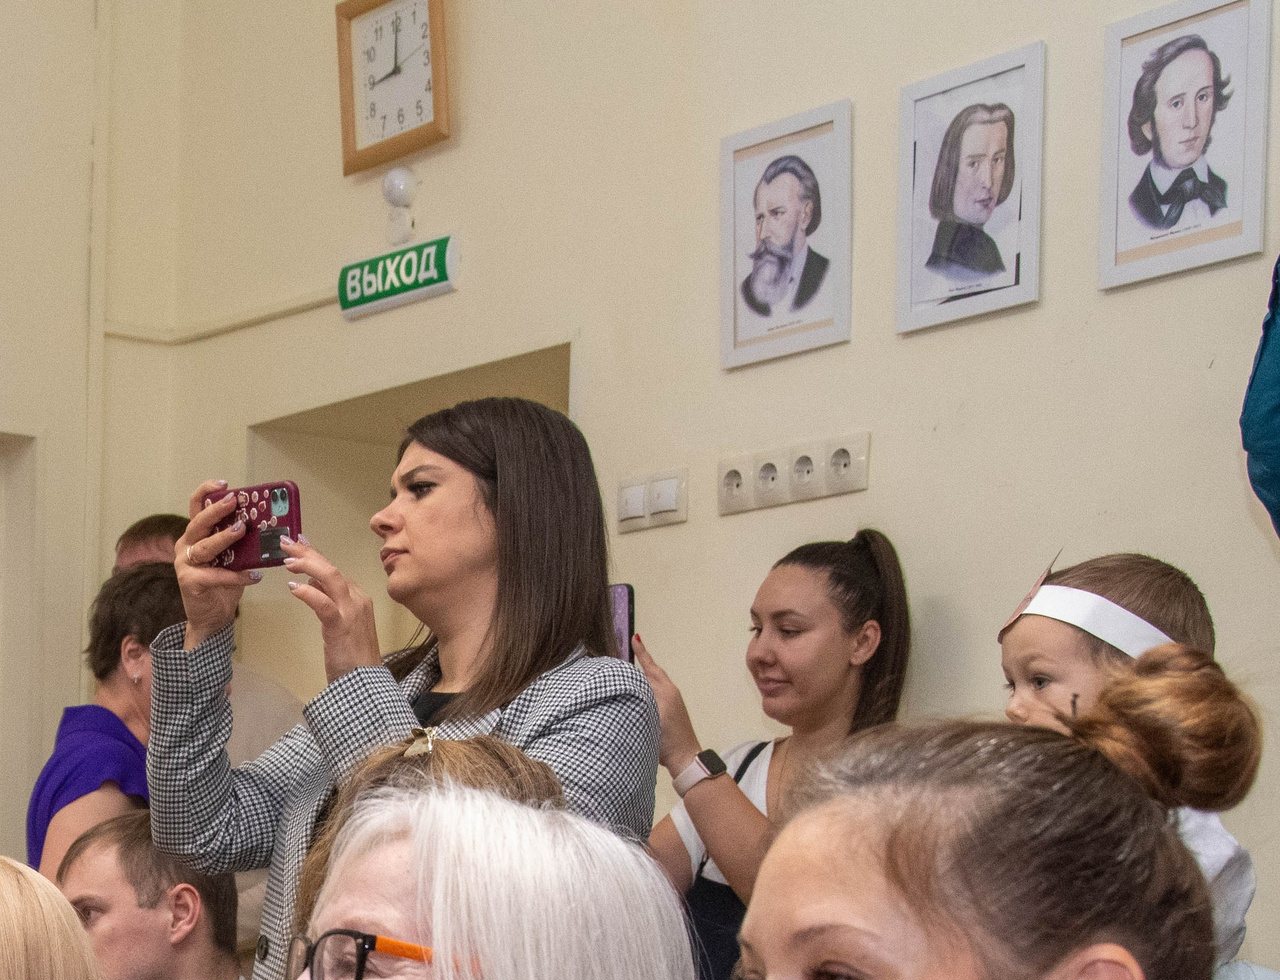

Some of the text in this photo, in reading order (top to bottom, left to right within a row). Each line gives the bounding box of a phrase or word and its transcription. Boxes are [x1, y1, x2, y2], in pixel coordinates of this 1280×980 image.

[374, 25, 382, 41] 11
[421, 22, 428, 39] 2
[363, 46, 376, 63] 10
[423, 50, 430, 66] 3
[368, 74, 375, 90] 9
[424, 78, 431, 92] 4
[370, 101, 376, 118] 8
[397, 108, 404, 125] 6
[416, 99, 423, 117] 5
[346, 245, 438, 301] ВЫХОД
